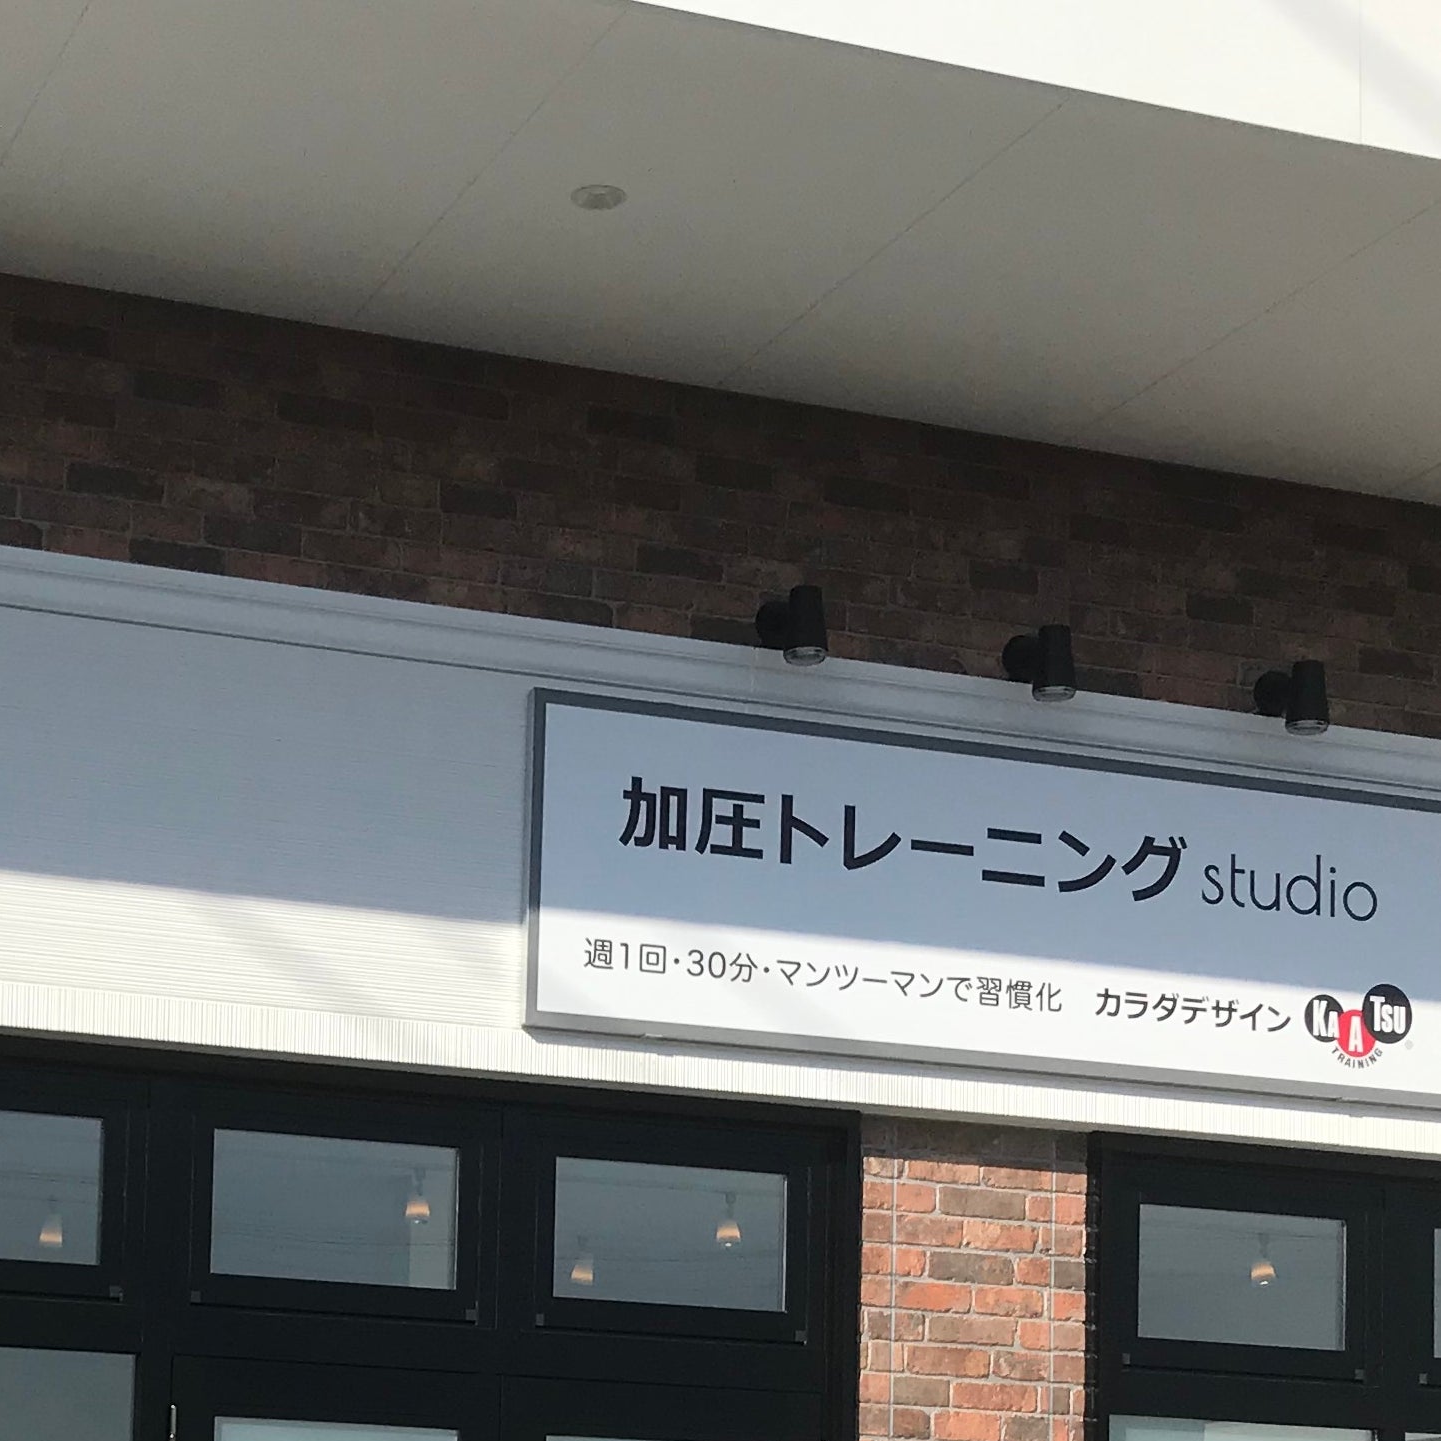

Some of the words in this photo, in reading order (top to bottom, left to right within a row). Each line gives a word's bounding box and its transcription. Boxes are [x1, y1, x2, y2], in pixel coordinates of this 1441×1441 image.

[619, 776, 1187, 902] 加圧トレーニング
[1201, 853, 1378, 922] studio
[1094, 987, 1292, 1033] カラダデザイン
[1331, 1046, 1383, 1069] TRAINING
